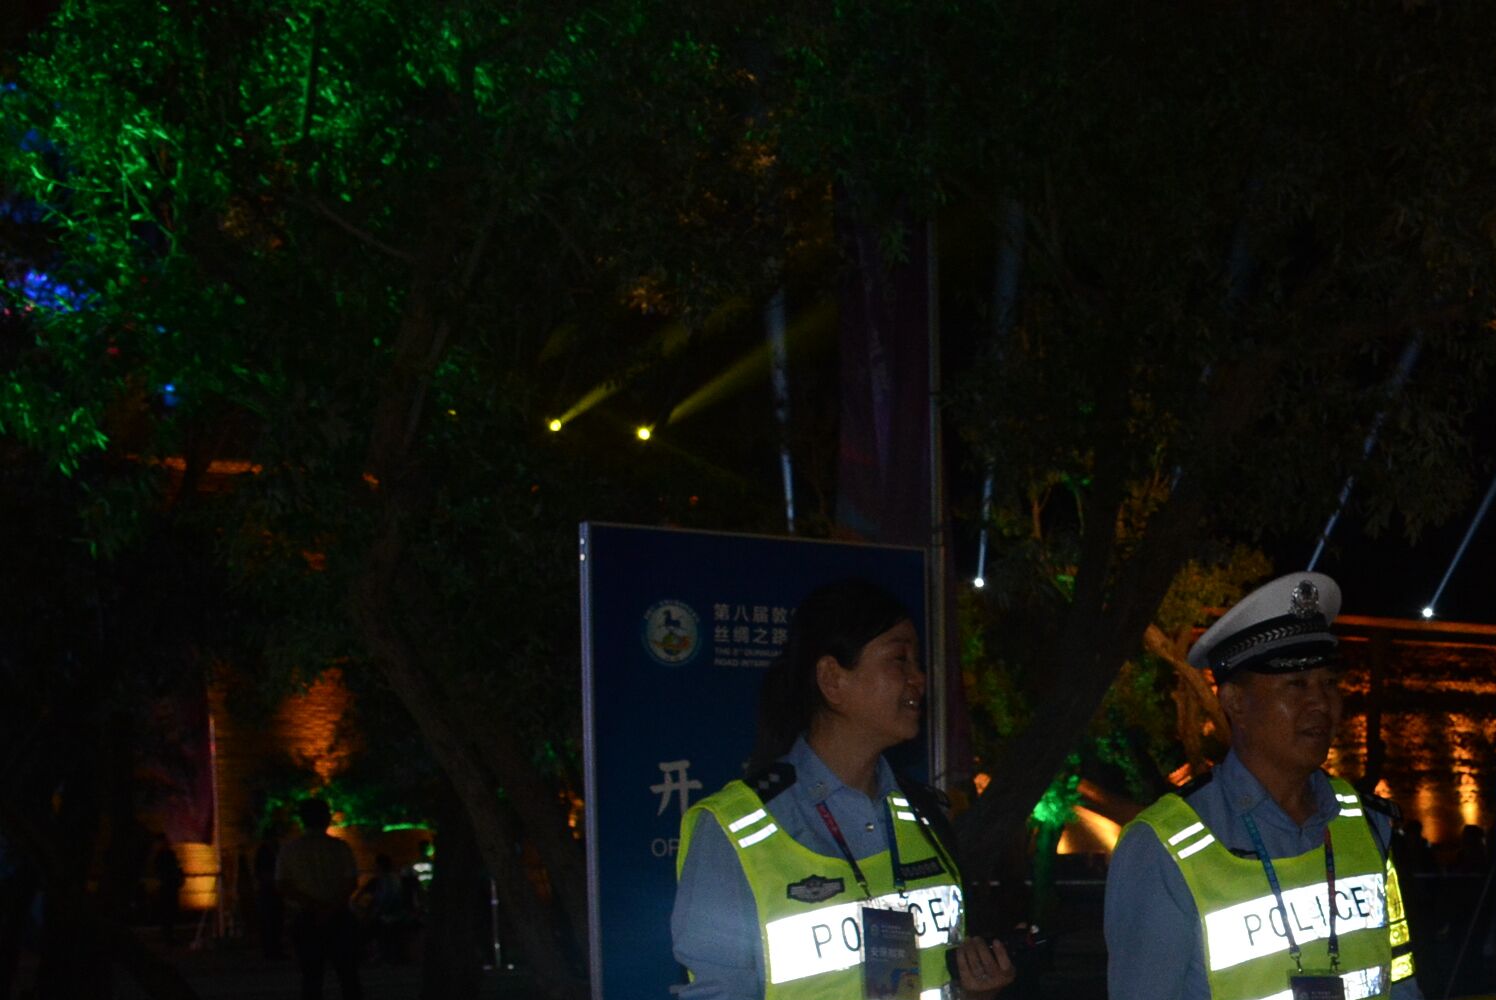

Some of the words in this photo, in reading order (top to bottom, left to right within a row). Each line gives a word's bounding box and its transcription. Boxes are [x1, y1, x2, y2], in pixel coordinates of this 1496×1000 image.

[713, 602, 796, 624] 第八届敦
[649, 759, 704, 817] 开
[811, 897, 951, 959] POCE
[1244, 886, 1371, 947] POLICE
